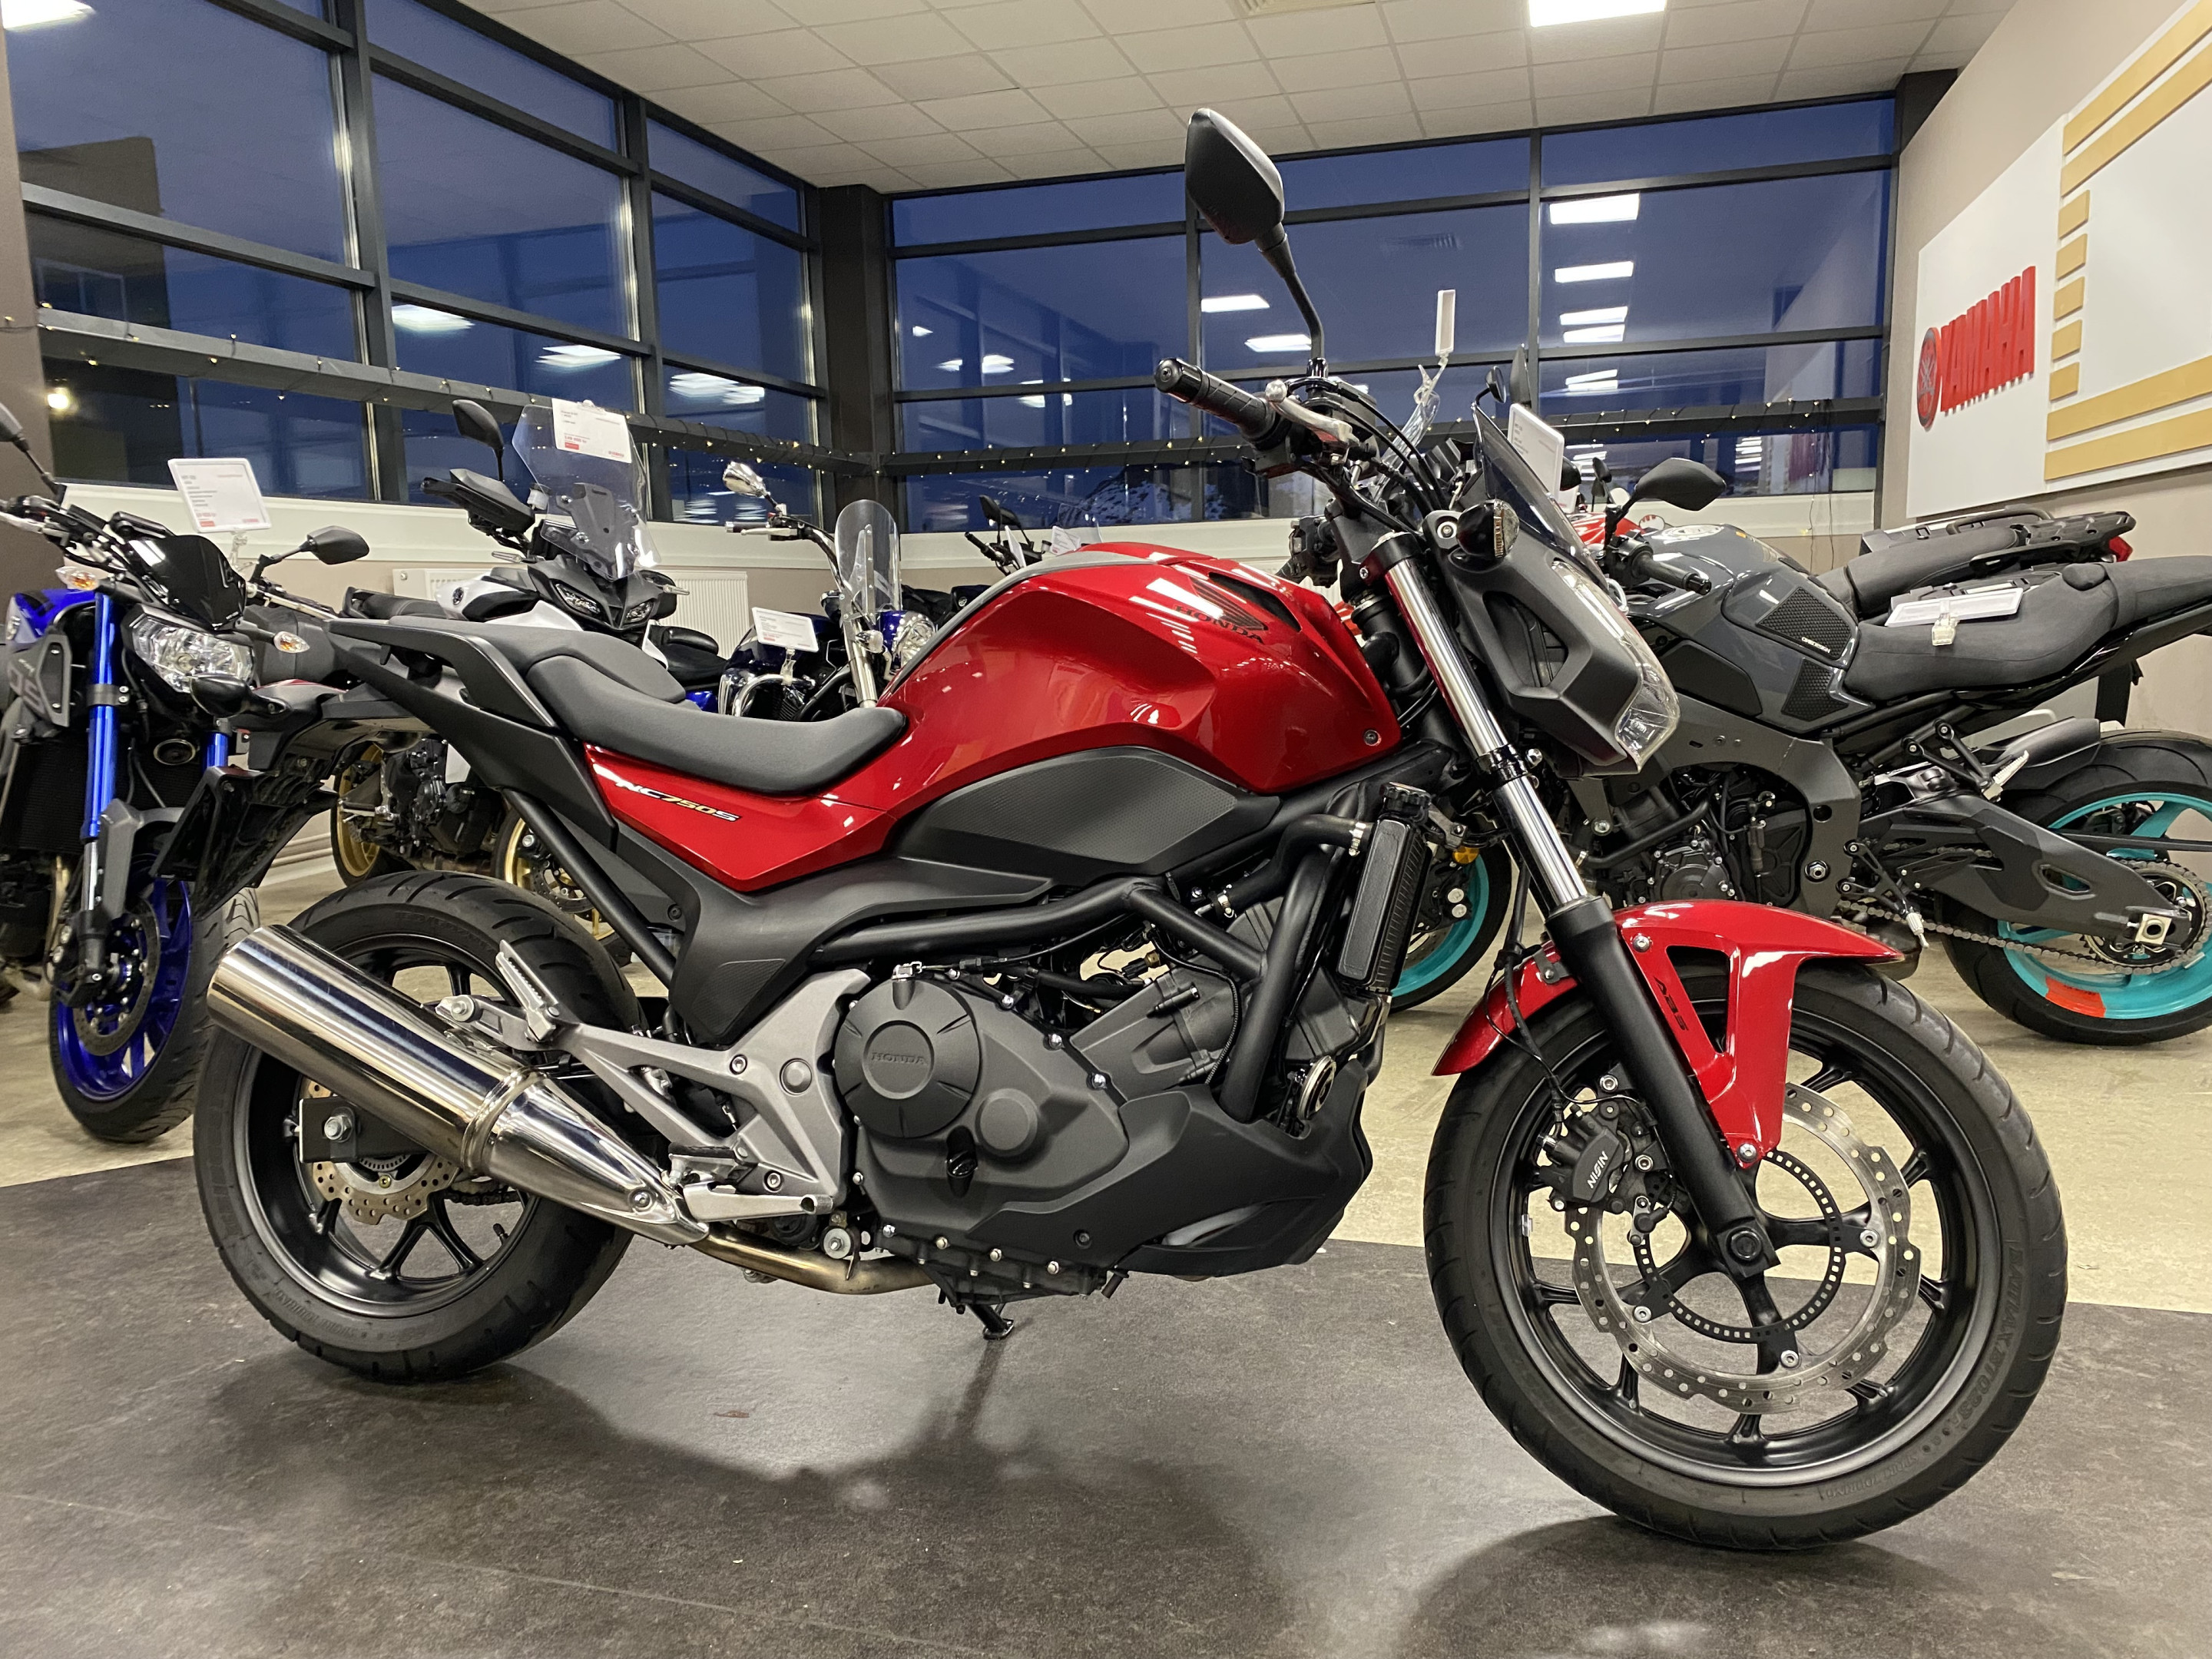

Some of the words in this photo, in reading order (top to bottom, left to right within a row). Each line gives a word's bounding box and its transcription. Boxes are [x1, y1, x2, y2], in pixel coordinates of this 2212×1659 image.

[1940, 266, 2036, 412] YAMAHA
[1172, 604, 1266, 646] HONDA
[614, 777, 742, 823] NC750S
[1653, 975, 1689, 1031] ABS
[870, 1051, 928, 1065] HONDA
